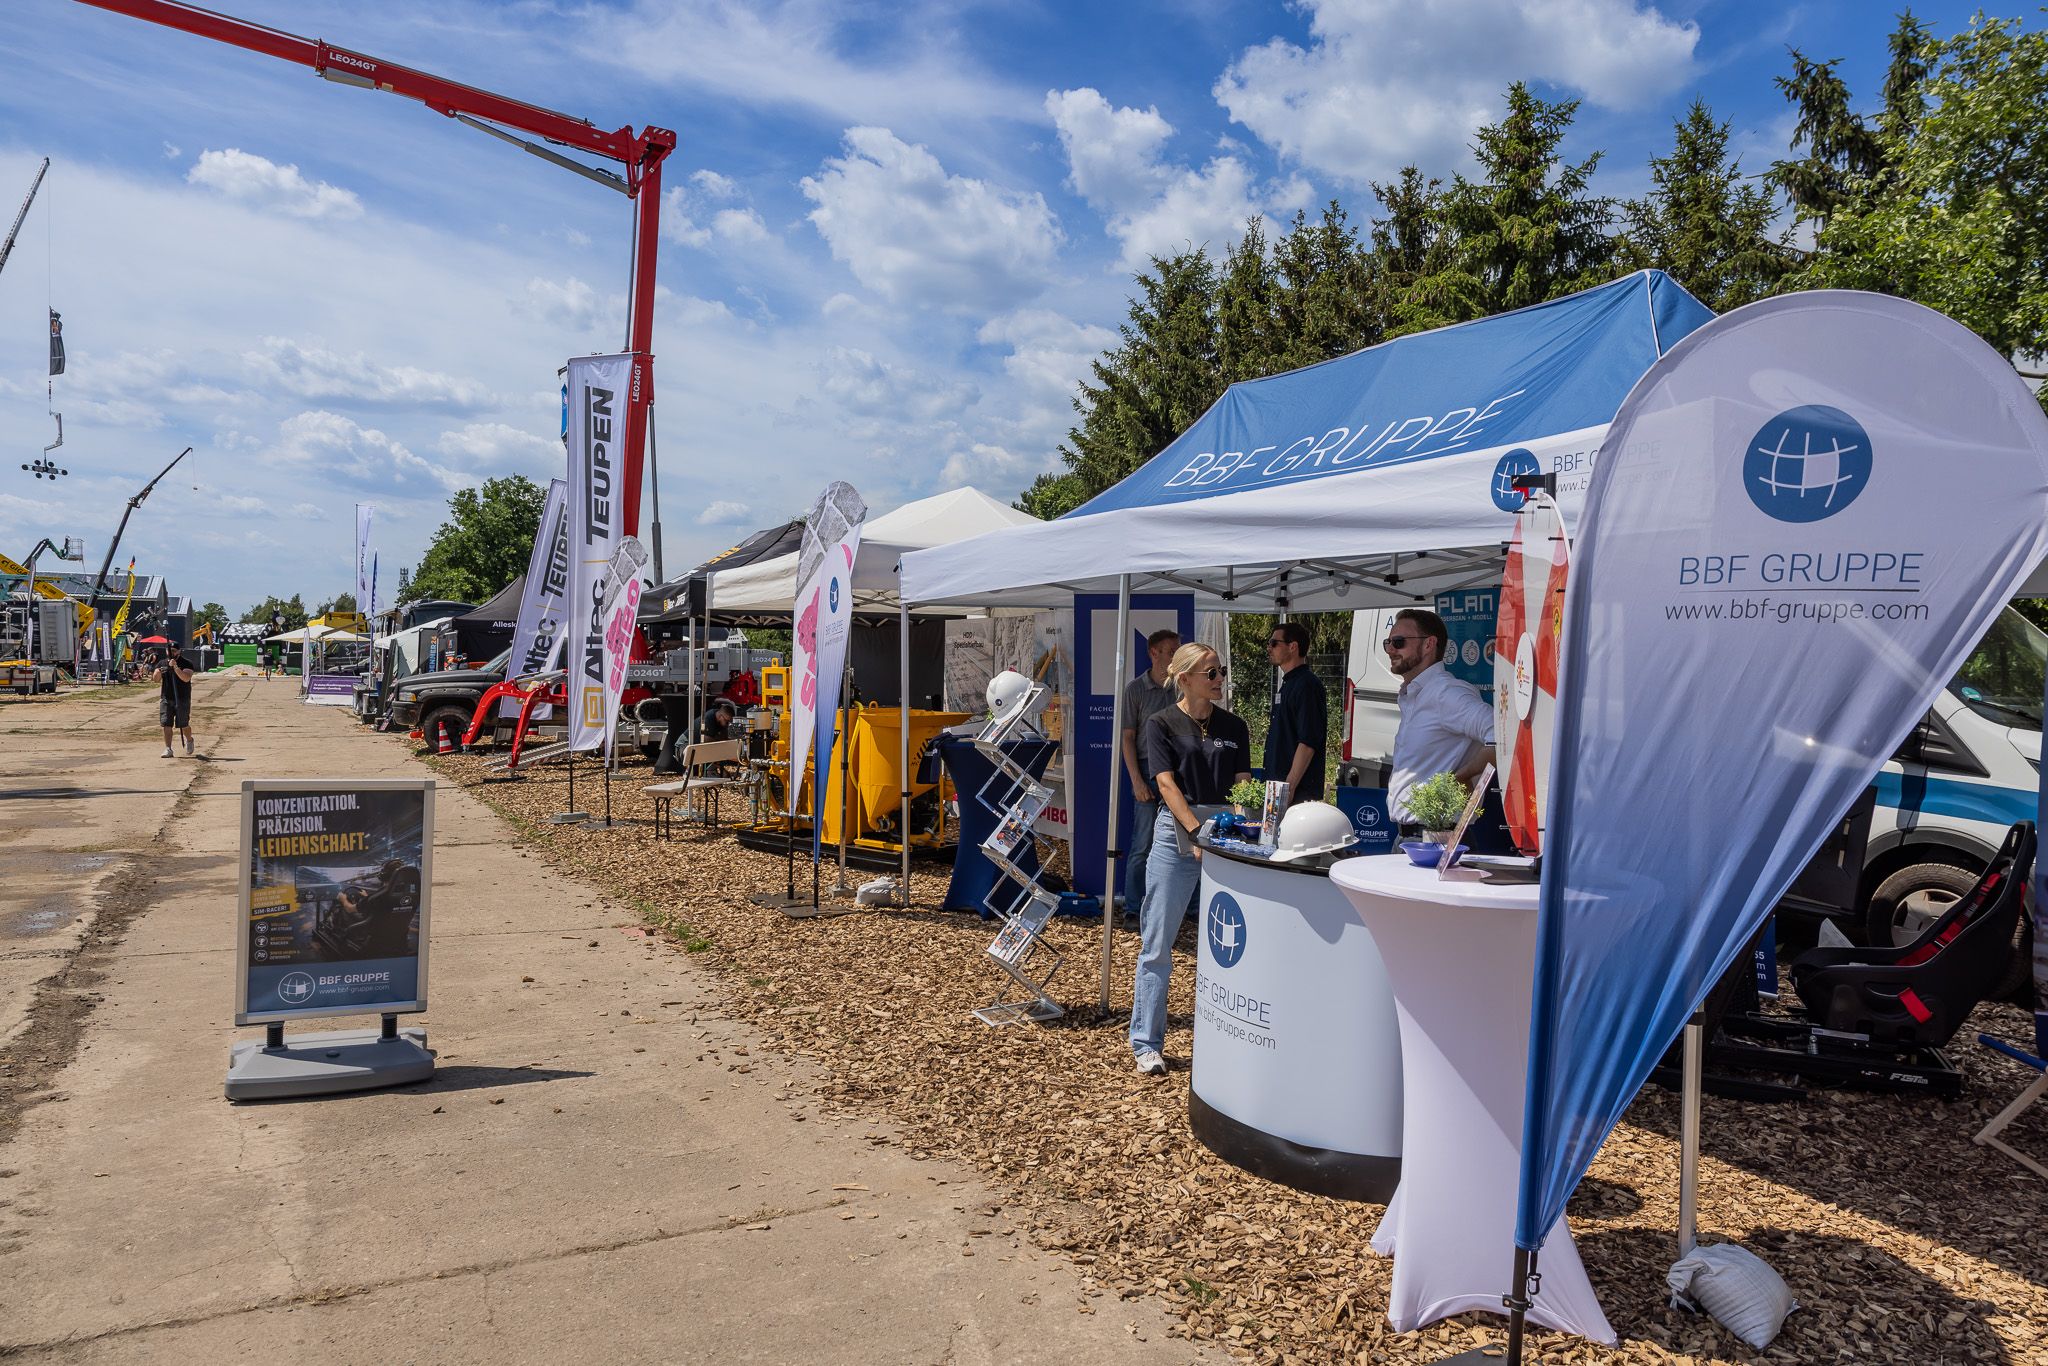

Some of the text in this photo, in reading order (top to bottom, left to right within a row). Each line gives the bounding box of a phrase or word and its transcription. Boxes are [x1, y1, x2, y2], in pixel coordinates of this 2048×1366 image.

[329, 51, 377, 72] LEO24GT
[632, 363, 642, 403] LEO24GT
[1164, 388, 1527, 488] BBF GRUPPE
[585, 385, 614, 546] TEUPEN
[1553, 451, 1585, 473] BBF
[1679, 553, 1924, 585] BBF GRUPPE
[1437, 594, 1493, 614] PLAN
[1665, 598, 1930, 624] www.bbf-gruppe.com
[627, 669, 665, 677] EO24GT
[257, 793, 361, 816] KONZENTRATION.
[258, 815, 327, 836] PRÄZISION.
[259, 831, 370, 858] LEIDENSCHAFT.
[253, 905, 288, 915] SIM-RACER!
[319, 971, 390, 986] BBF GRUPPE
[1211, 982, 1272, 1024] GRUPPE
